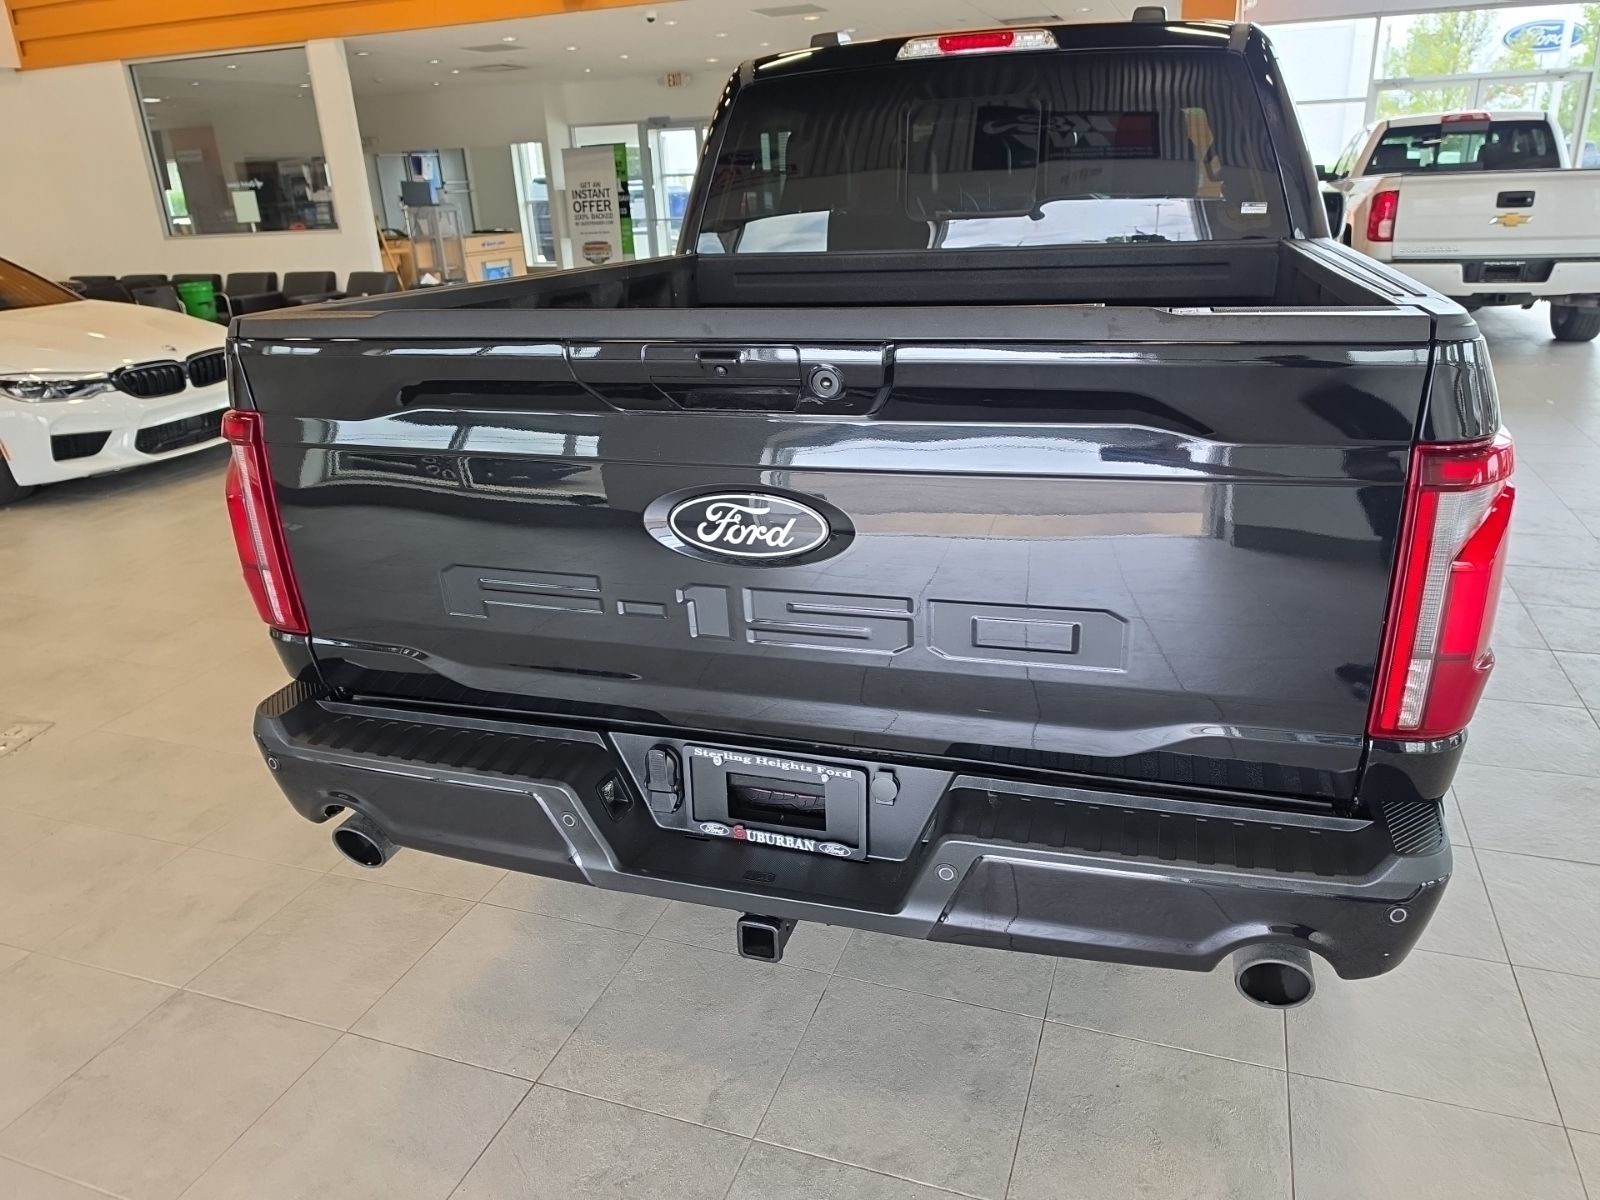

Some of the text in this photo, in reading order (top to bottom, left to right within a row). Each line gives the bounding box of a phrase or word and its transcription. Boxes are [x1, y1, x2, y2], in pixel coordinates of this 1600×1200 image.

[571, 188, 611, 200] INSTANT
[573, 199, 612, 213] OFFER
[697, 502, 797, 548] Ford
[440, 563, 1128, 673] F-150
[694, 748, 852, 779] Sterling Heights Ford
[733, 825, 815, 851] SUBURBAN
